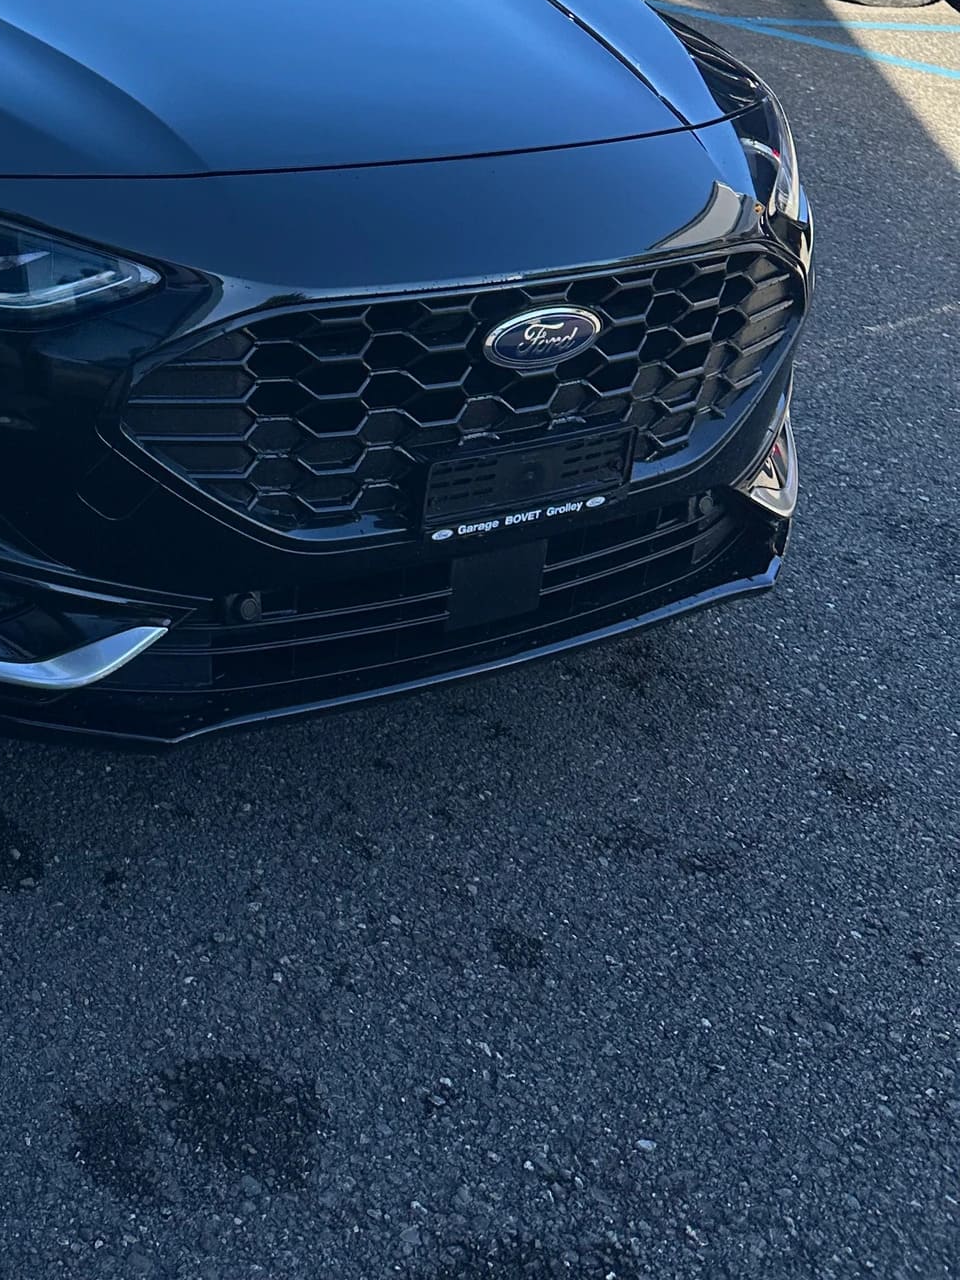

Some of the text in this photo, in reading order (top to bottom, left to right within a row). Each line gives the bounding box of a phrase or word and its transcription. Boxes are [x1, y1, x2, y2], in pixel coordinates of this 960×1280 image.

[519, 321, 579, 351] Ford
[457, 519, 500, 535] Garage
[504, 509, 542, 526] BOVET
[546, 501, 584, 517] Grolley
